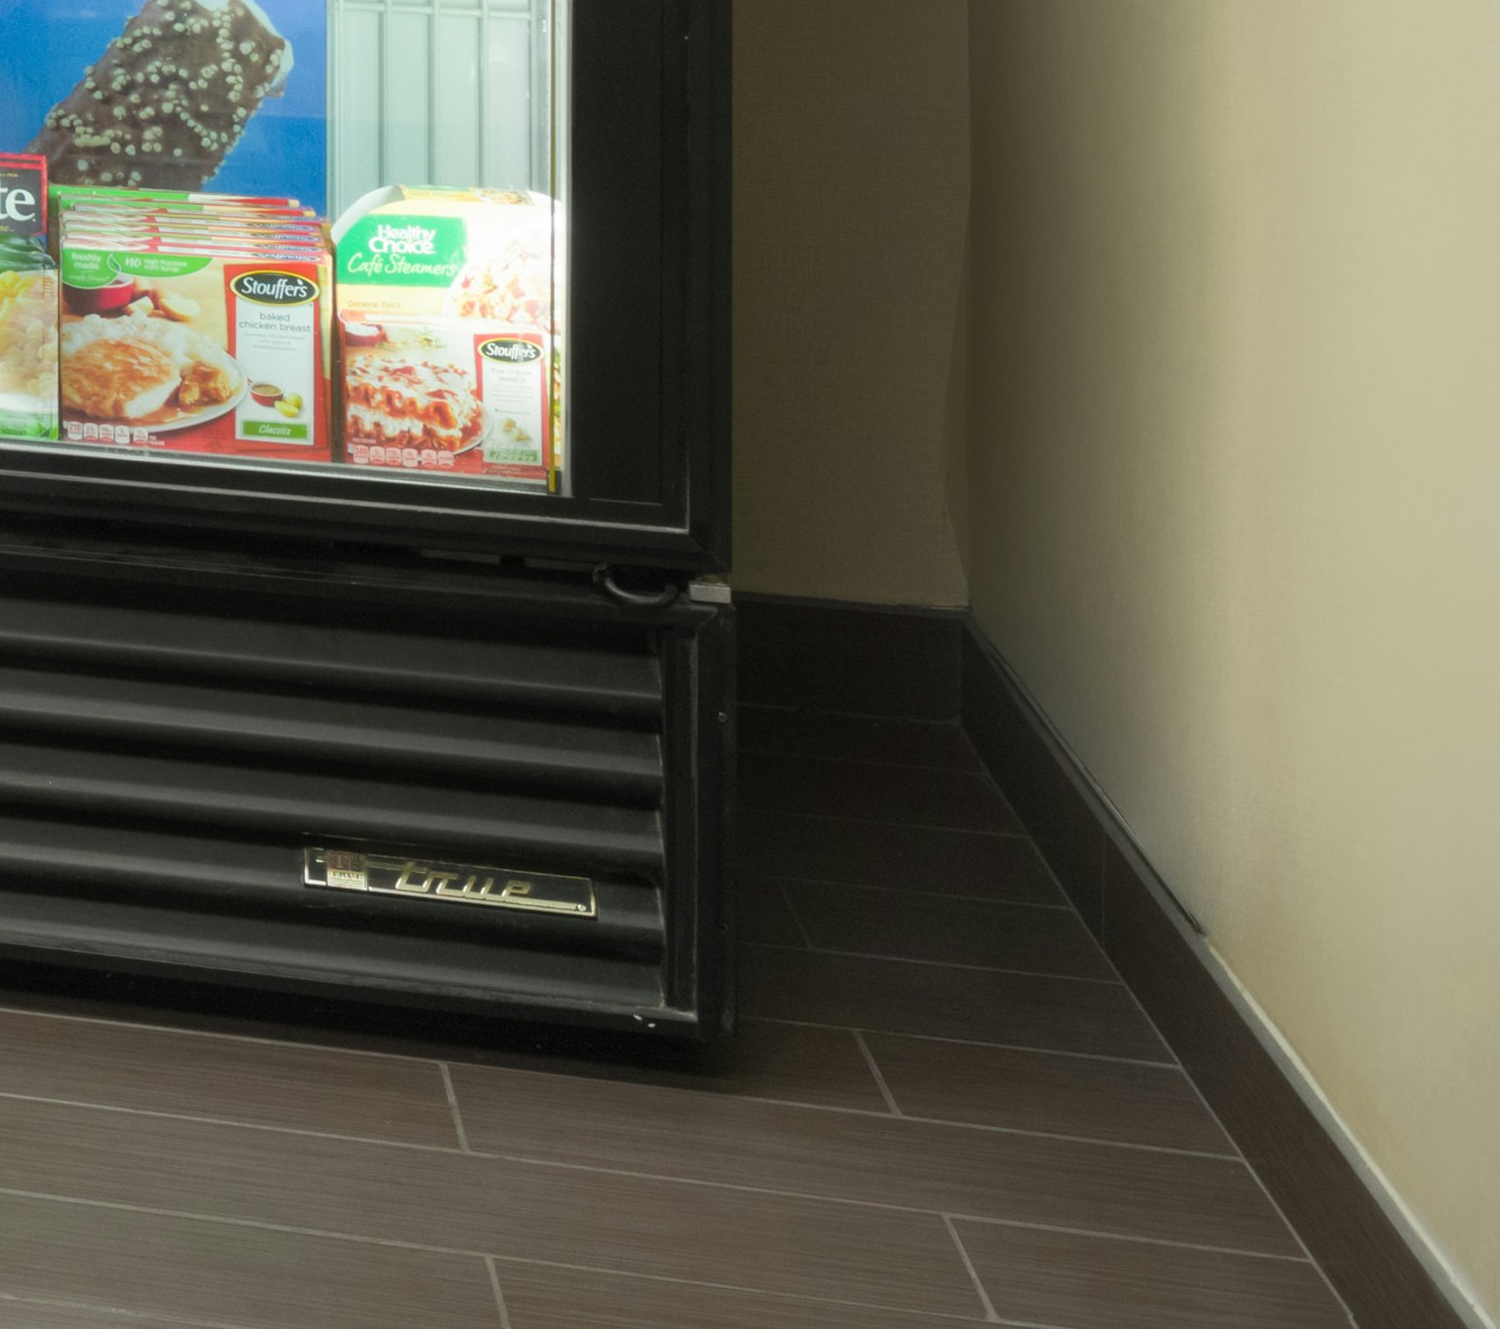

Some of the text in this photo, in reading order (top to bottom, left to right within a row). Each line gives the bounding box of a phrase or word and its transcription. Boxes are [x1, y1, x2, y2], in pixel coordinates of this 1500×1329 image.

[377, 224, 436, 240] Healthy
[369, 237, 435, 254] Choice
[348, 253, 455, 276] Café Steamers
[241, 277, 308, 299] Stouffer's
[259, 312, 290, 322] baked
[239, 321, 311, 333] chicken breast
